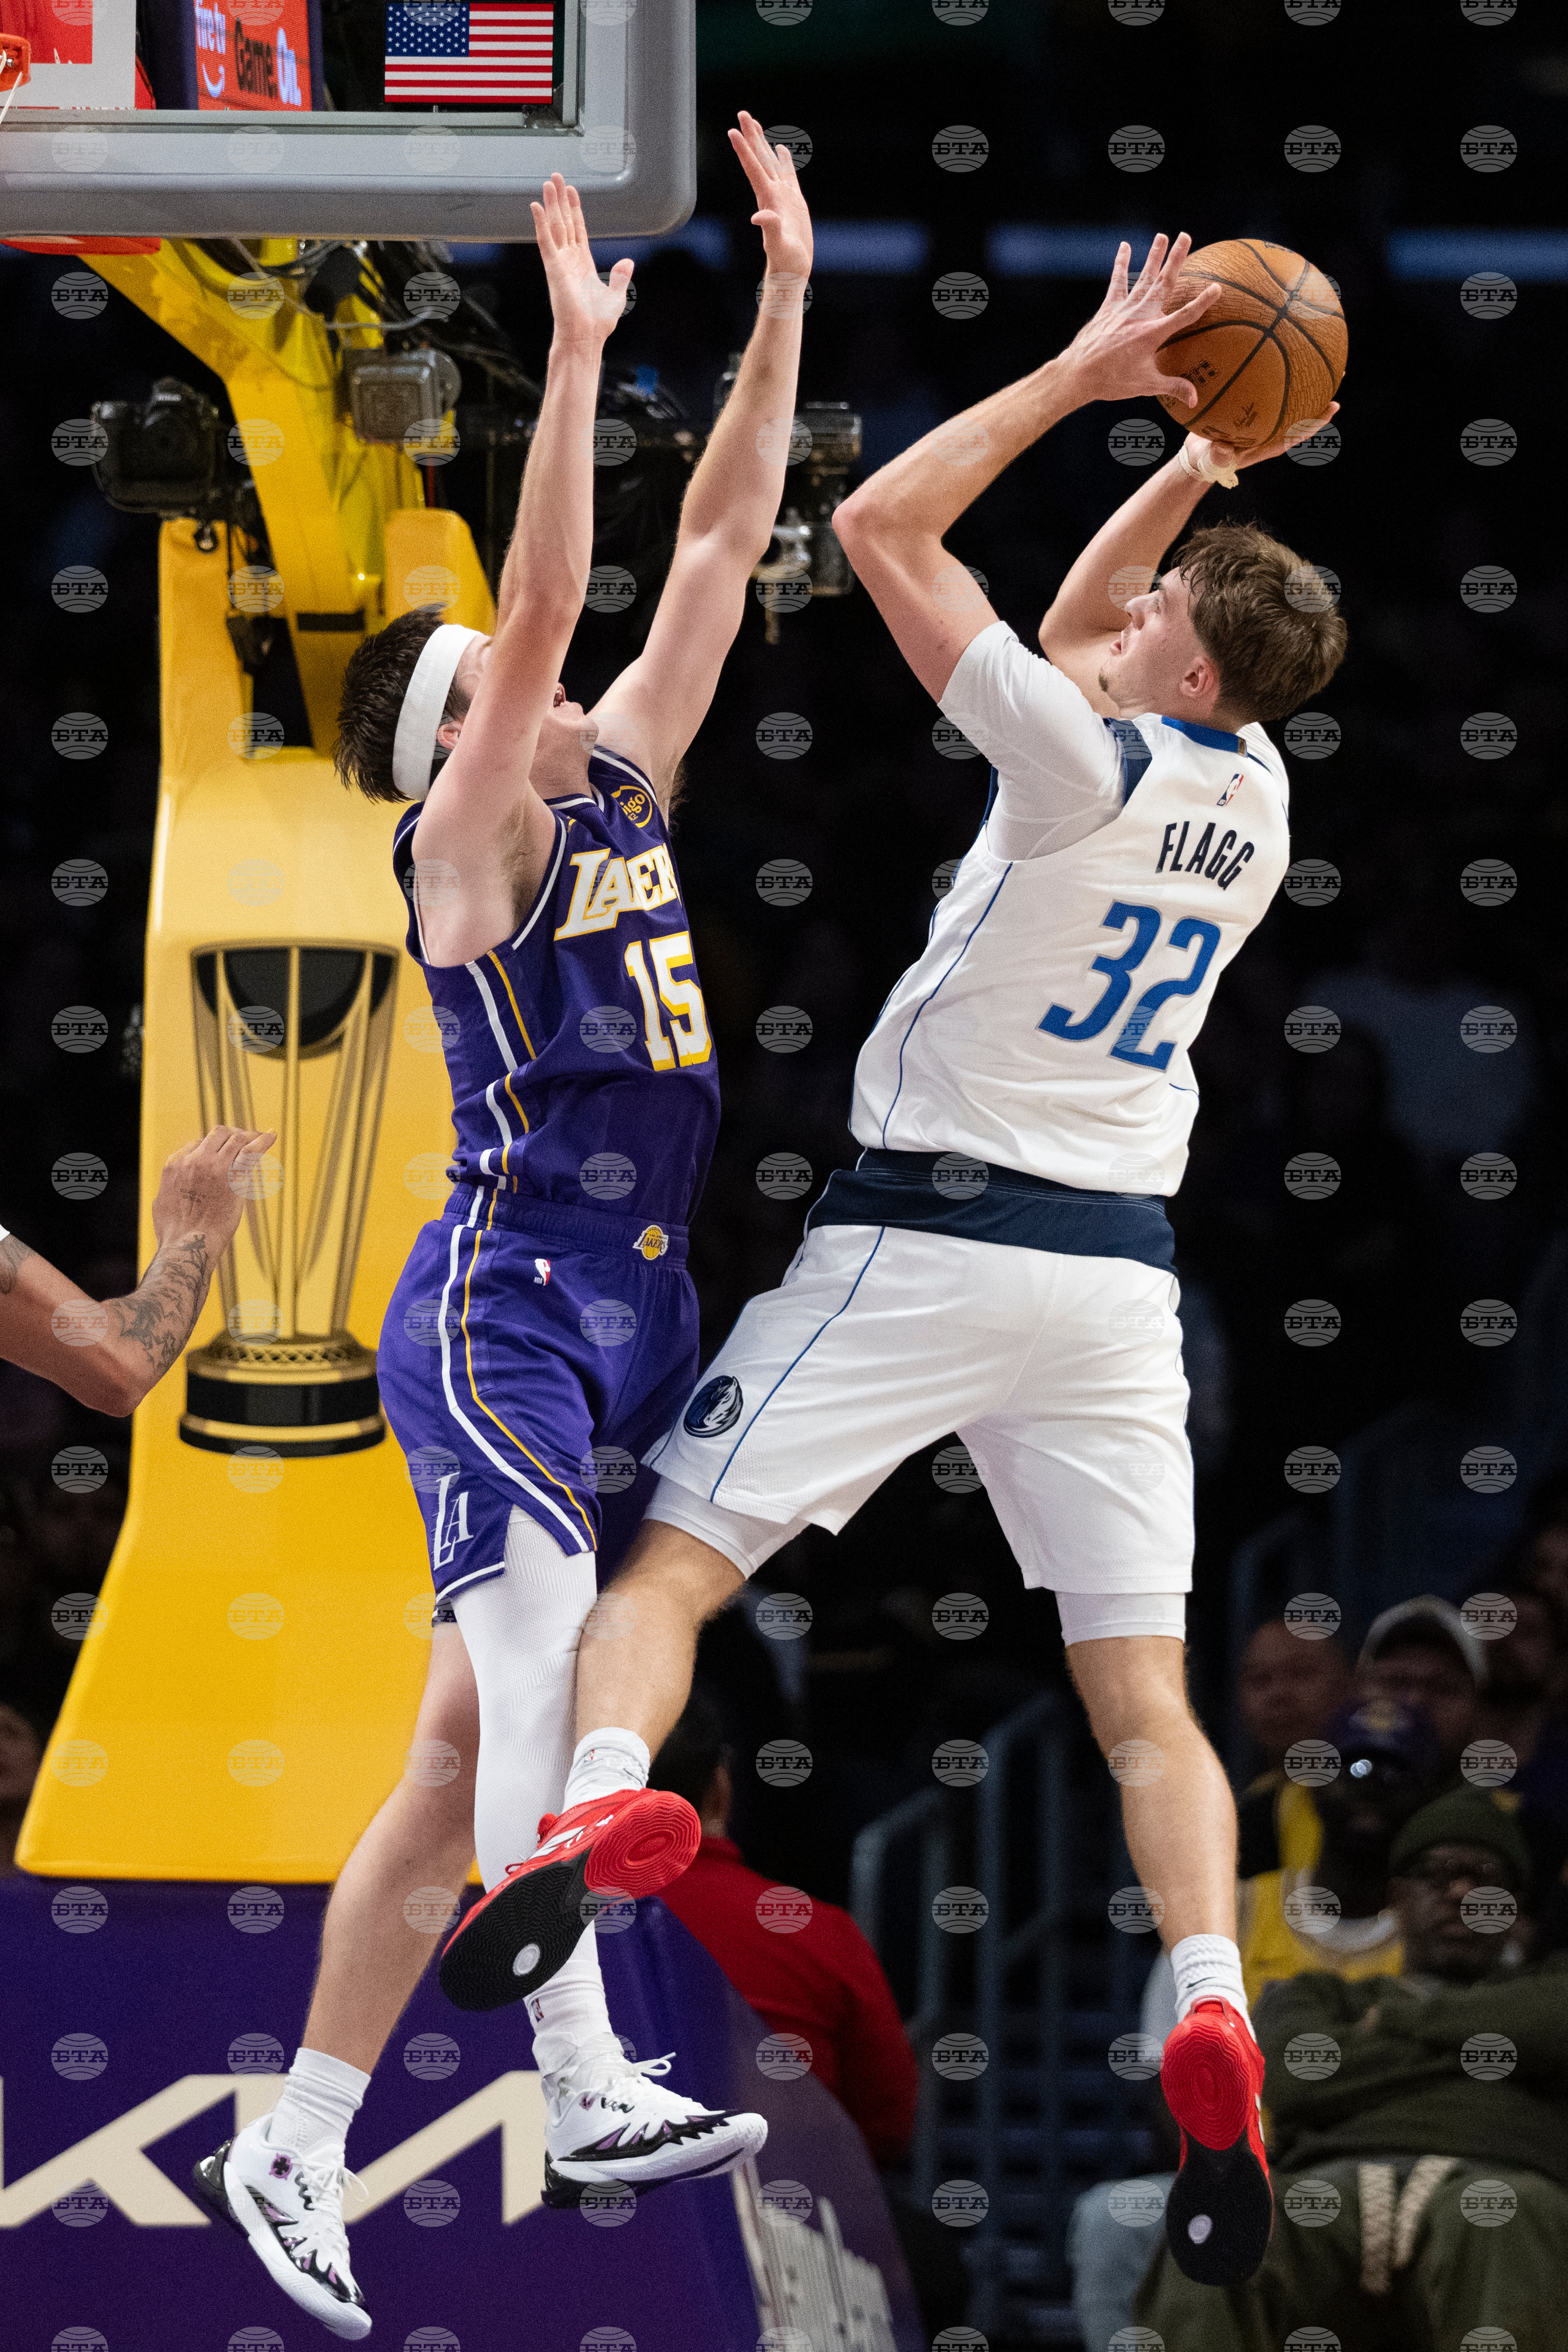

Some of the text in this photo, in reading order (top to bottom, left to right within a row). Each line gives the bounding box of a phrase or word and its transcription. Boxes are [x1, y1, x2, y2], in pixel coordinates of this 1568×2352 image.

[1155, 820, 1255, 891] FLAGG
[624, 930, 712, 1072] 15
[1035, 899, 1222, 1073] 32
[636, 1232, 667, 1253] LAKERS
[432, 1472, 474, 1571] LA
